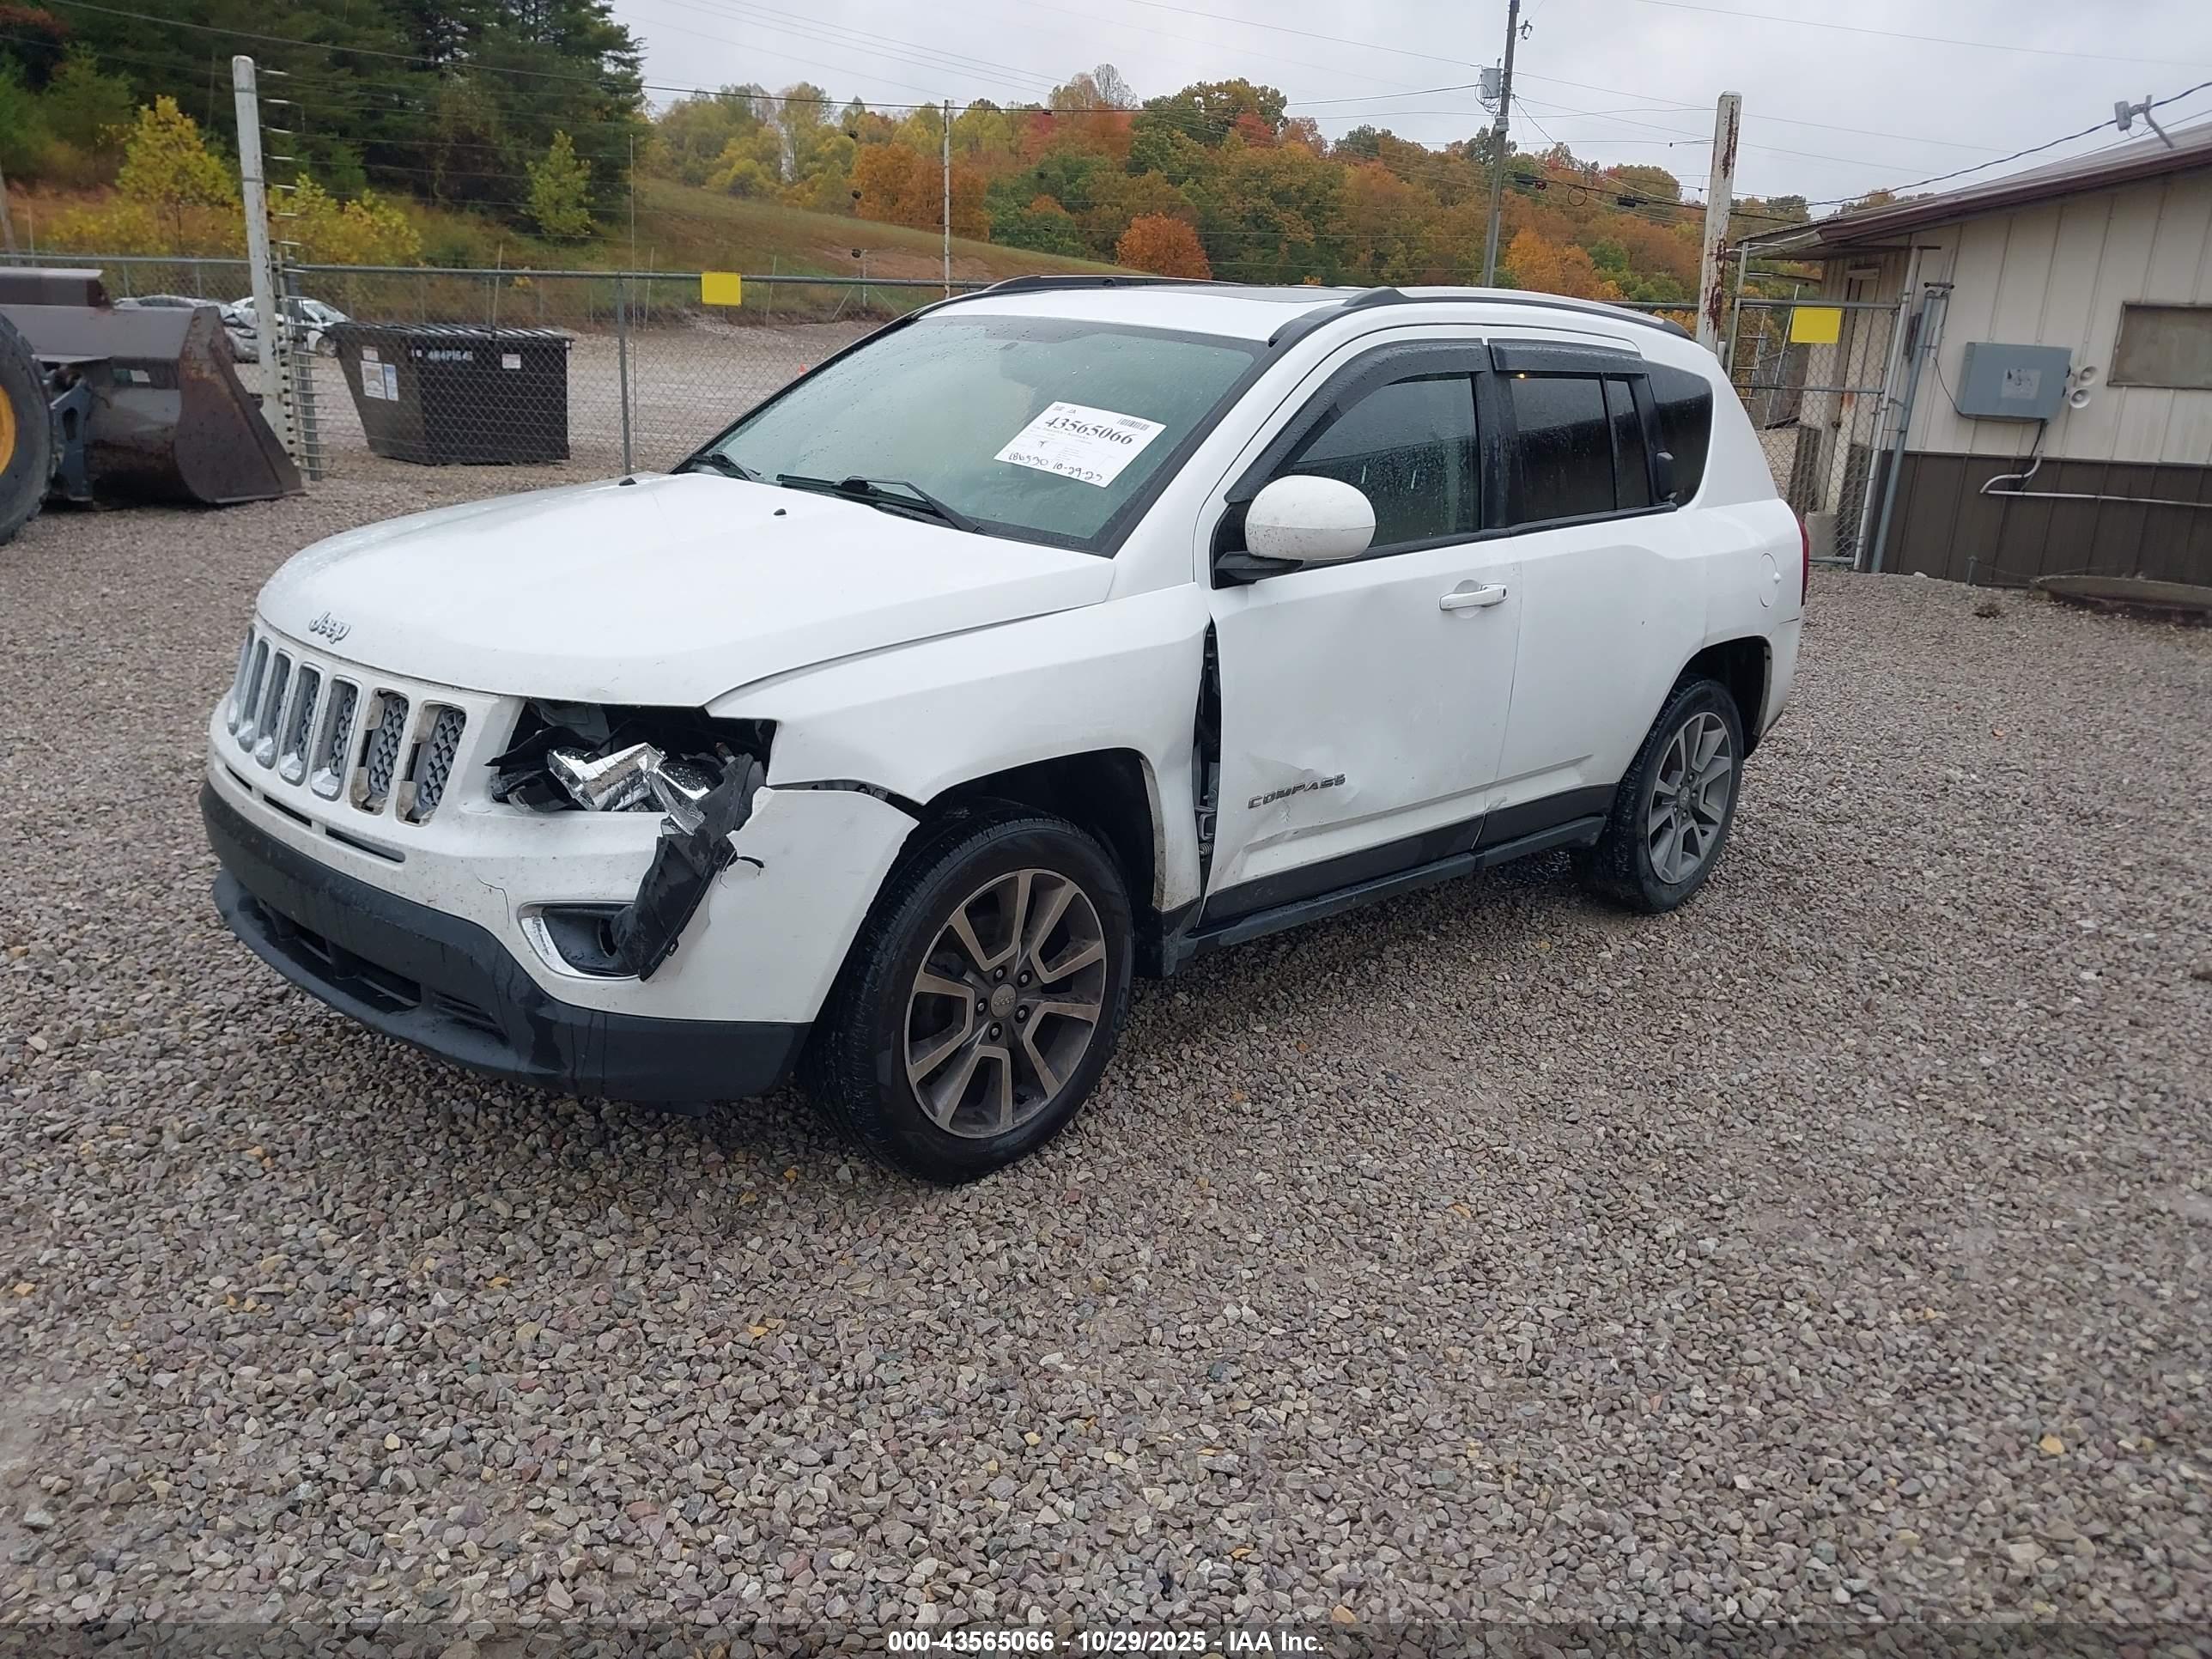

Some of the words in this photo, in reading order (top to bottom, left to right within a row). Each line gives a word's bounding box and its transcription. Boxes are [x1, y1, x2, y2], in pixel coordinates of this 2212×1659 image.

[1044, 416, 1139, 446] 43565066
[309, 611, 351, 645] Jeep
[1248, 773, 1346, 809] COMPASS
